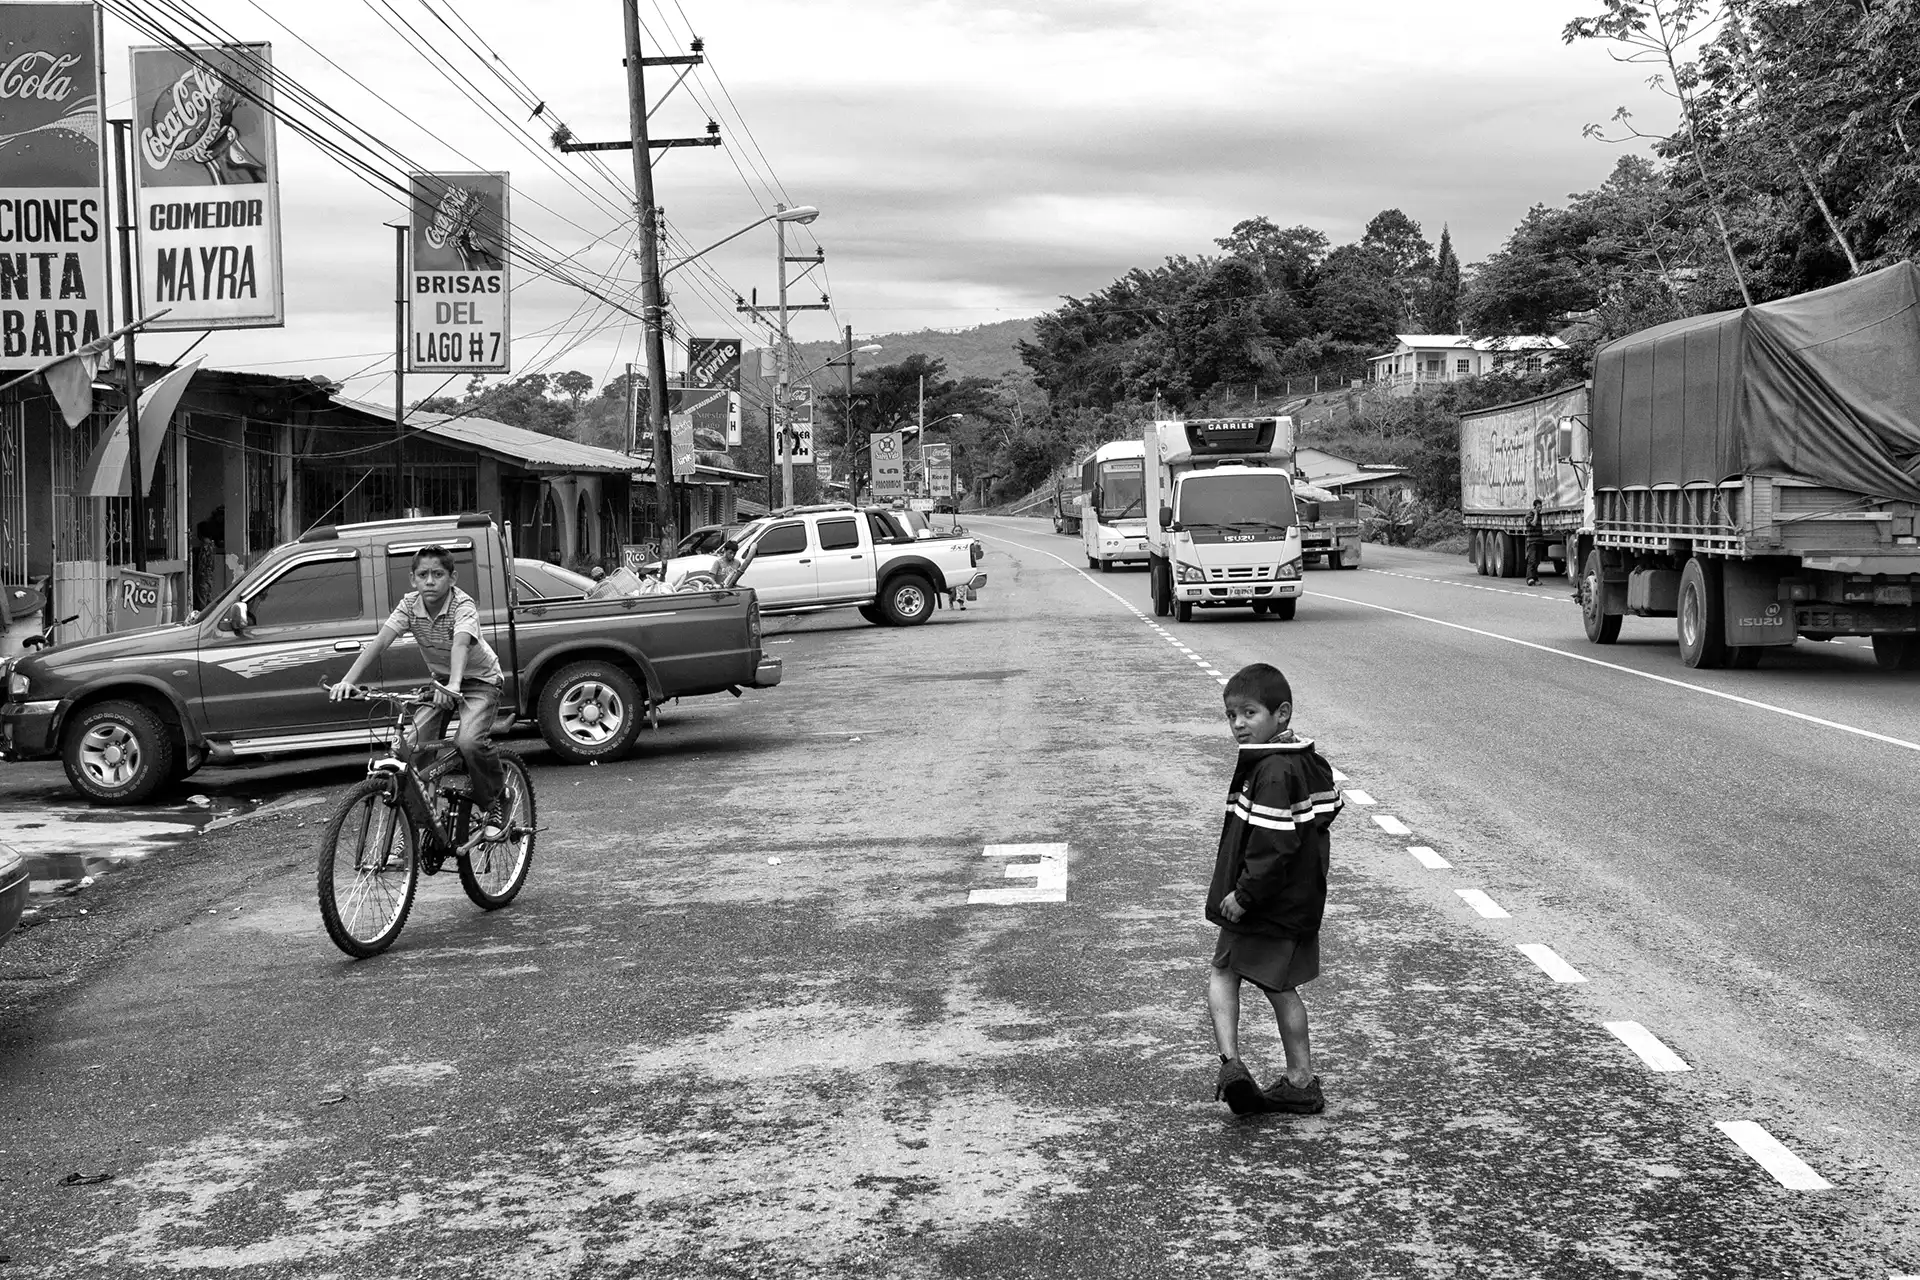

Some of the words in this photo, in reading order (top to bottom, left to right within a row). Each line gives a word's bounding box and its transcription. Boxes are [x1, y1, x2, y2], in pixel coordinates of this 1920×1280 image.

[141, 54, 223, 170] Coca-Cola
[0, 199, 98, 242] CIONES
[150, 199, 262, 231] COMEDOR
[0, 252, 86, 300] NTA
[156, 245, 257, 302] MAYRA
[416, 275, 500, 294] BRISAS
[436, 301, 483, 325] DEL
[416, 332, 462, 362] LAGO
[695, 344, 737, 387] Sprite
[1208, 422, 1254, 430] CARRIER
[625, 550, 645, 567] Rico
[646, 542, 660, 559] Ri
[124, 579, 156, 613] Rico
[1739, 617, 1783, 626] ISUZU
